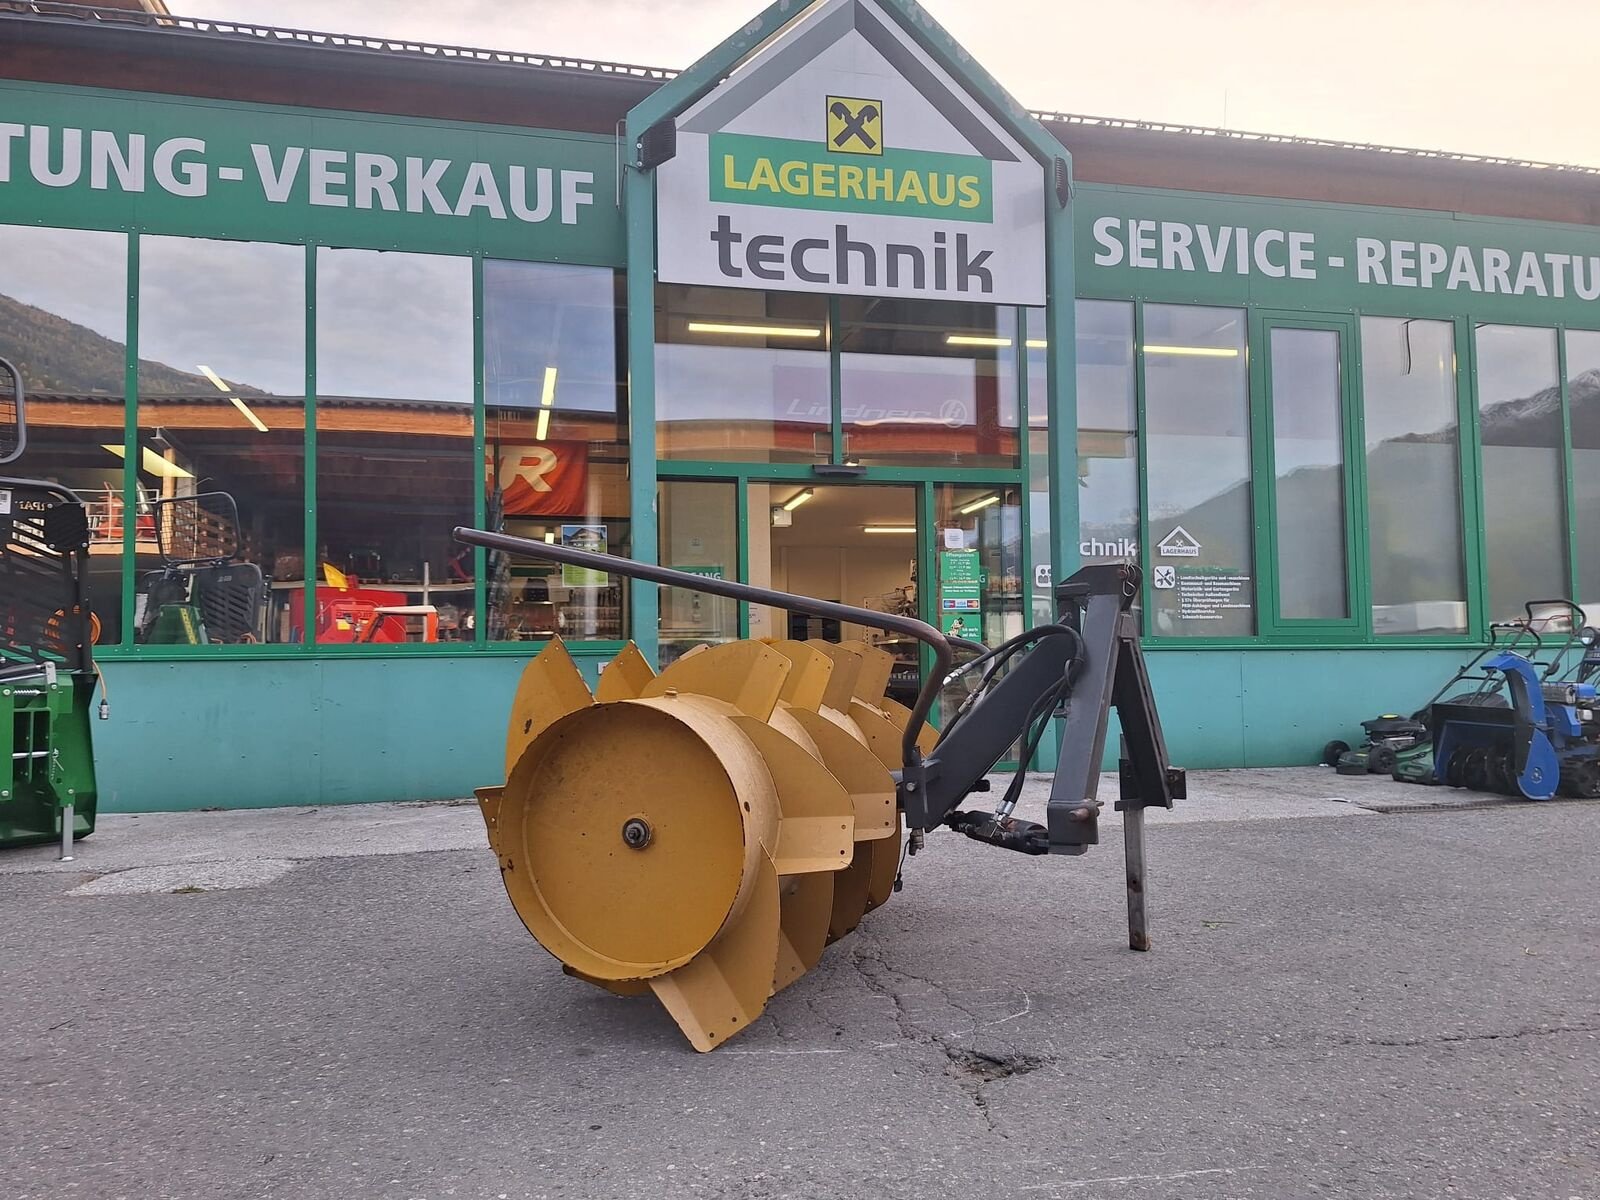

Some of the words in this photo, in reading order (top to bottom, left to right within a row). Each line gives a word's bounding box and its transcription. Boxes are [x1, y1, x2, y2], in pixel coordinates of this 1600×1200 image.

[723, 154, 981, 209] LAGERHAUS
[710, 215, 994, 294] technik
[1092, 216, 1317, 280] SERVICE
[1356, 237, 1600, 301] REPARATU
